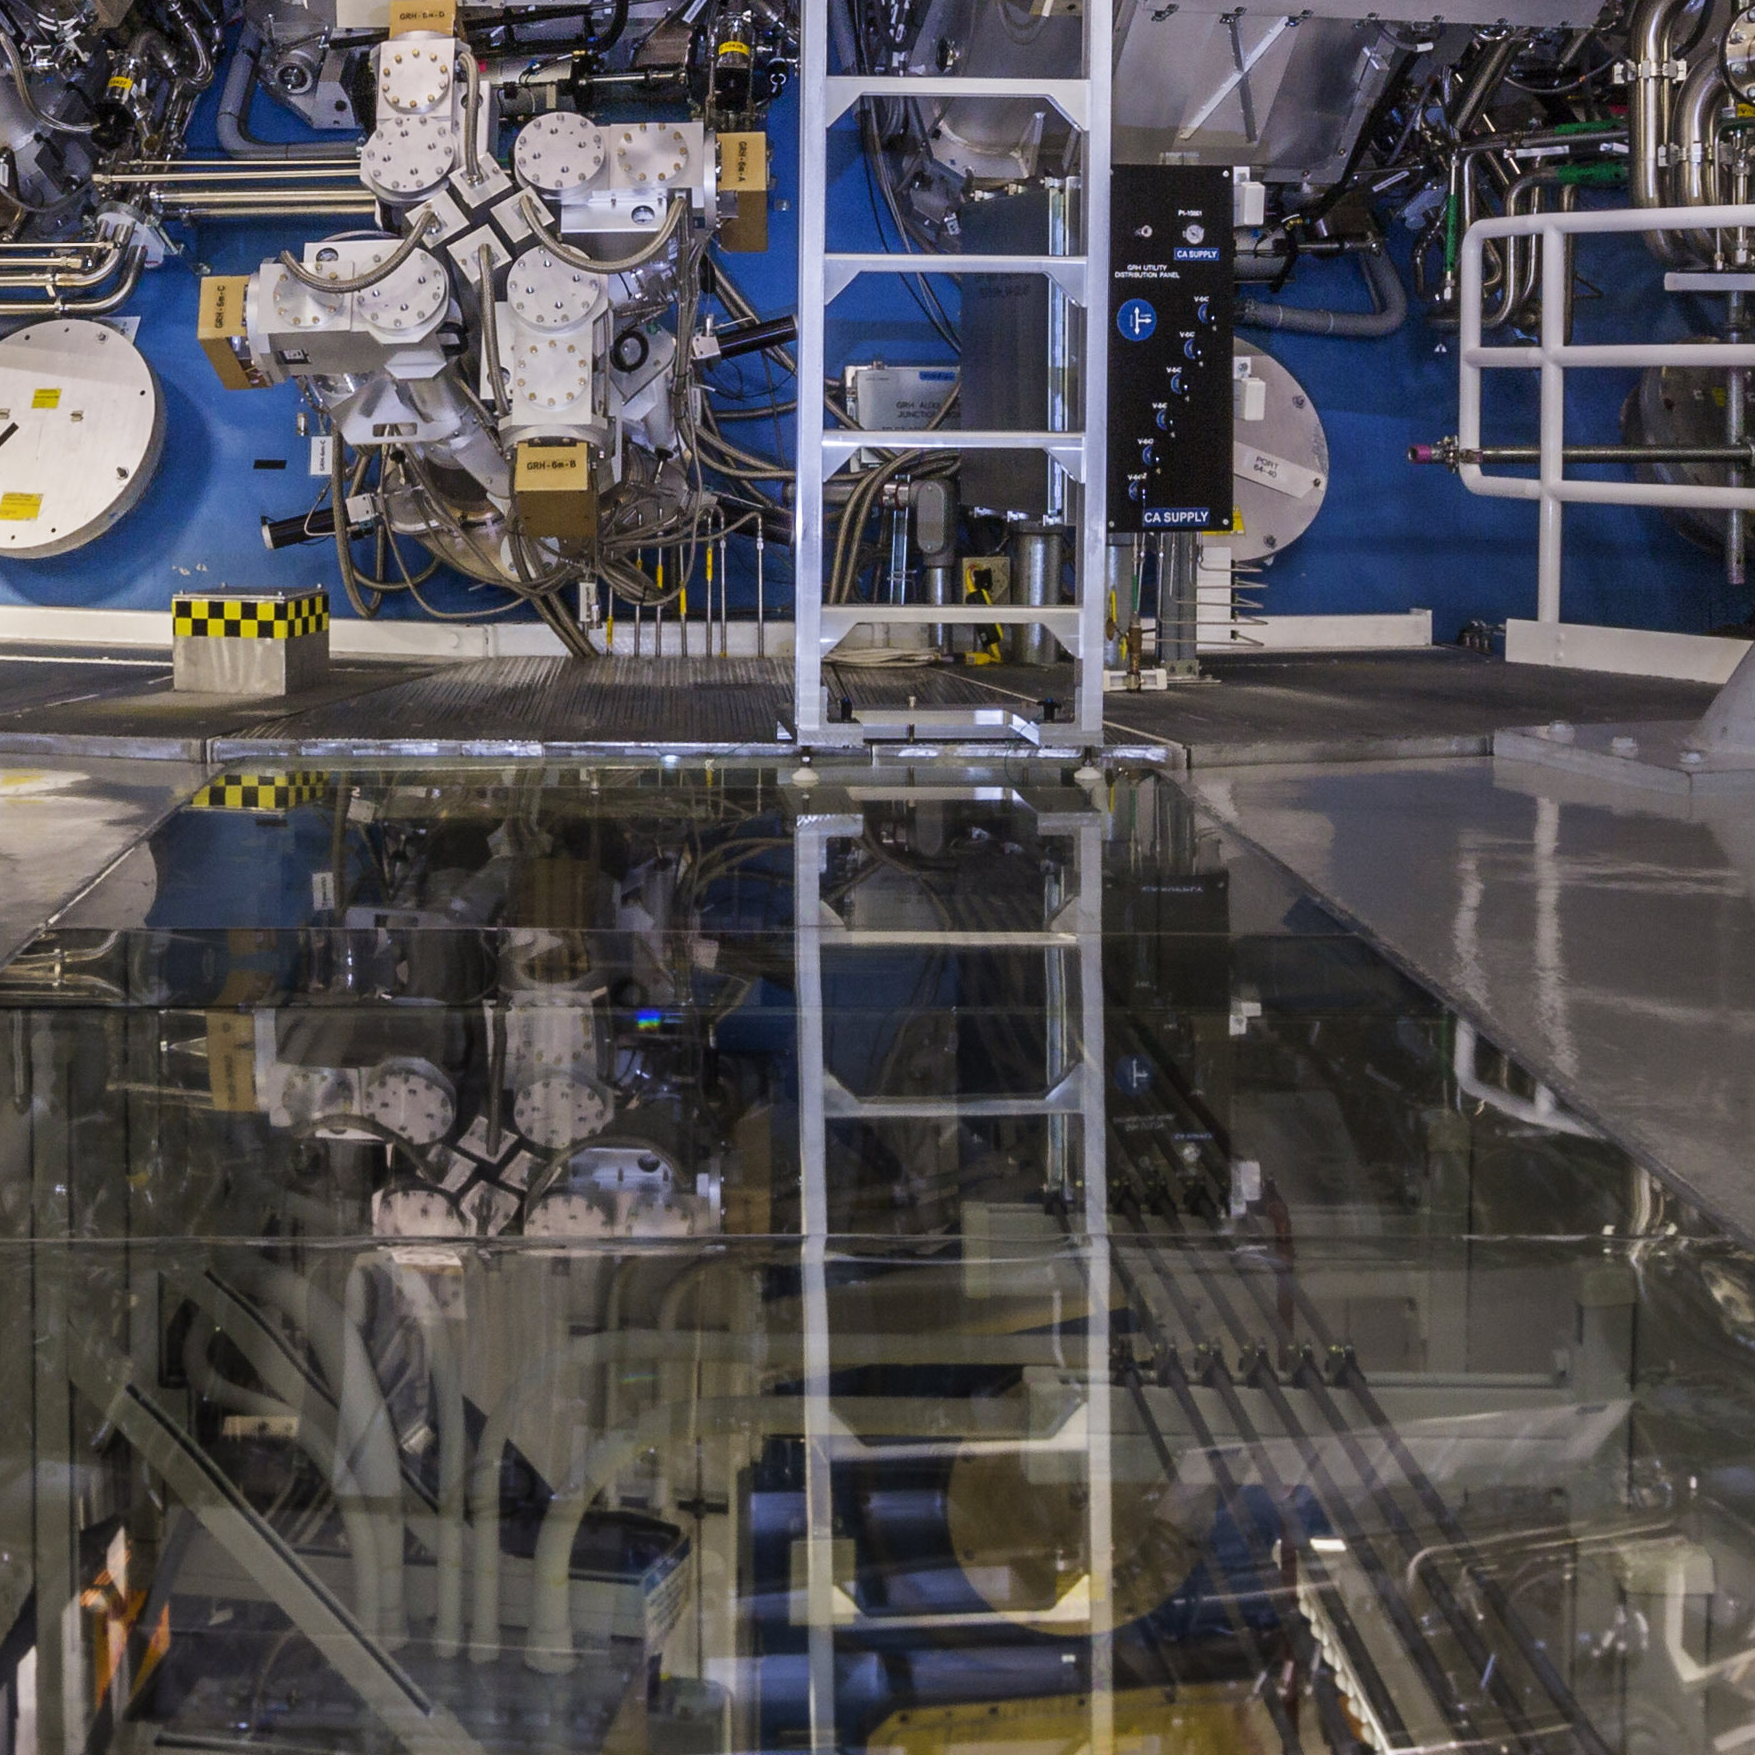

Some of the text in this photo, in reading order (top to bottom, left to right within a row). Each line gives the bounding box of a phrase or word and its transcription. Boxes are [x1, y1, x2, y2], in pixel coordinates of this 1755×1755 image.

[1177, 250, 1218, 258] CA SUPPLY
[1255, 455, 1280, 470] PORT
[1144, 511, 1209, 523] CA SUPPLY
